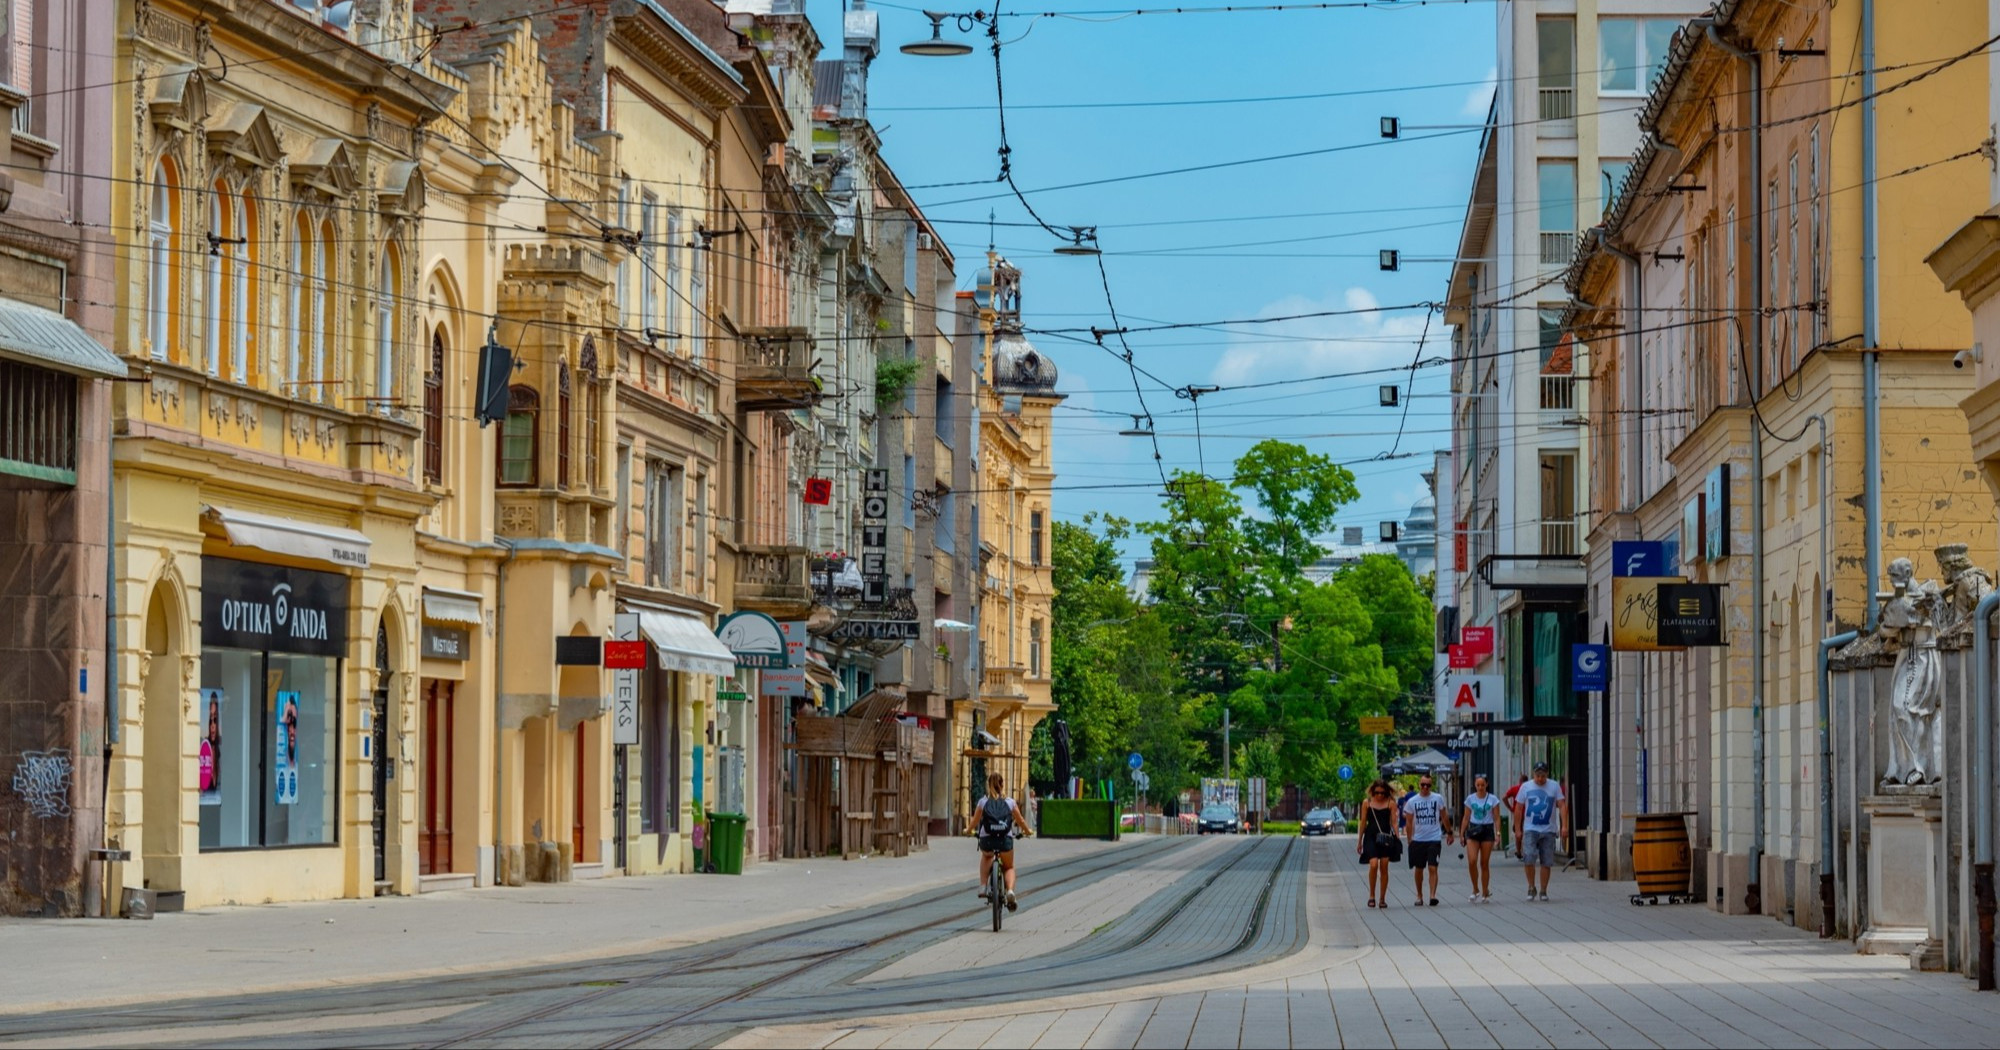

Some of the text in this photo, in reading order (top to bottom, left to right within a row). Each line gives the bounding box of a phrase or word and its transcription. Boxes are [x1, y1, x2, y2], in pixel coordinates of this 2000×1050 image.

[864, 470, 886, 602] HOTEL
[222, 598, 328, 640] OPTIKA ANDA
[1662, 618, 1717, 626] ZLATARNA CELJE
[735, 654, 770, 667] wan
[764, 674, 804, 682] bankomat
[1454, 681, 1481, 708] A1
